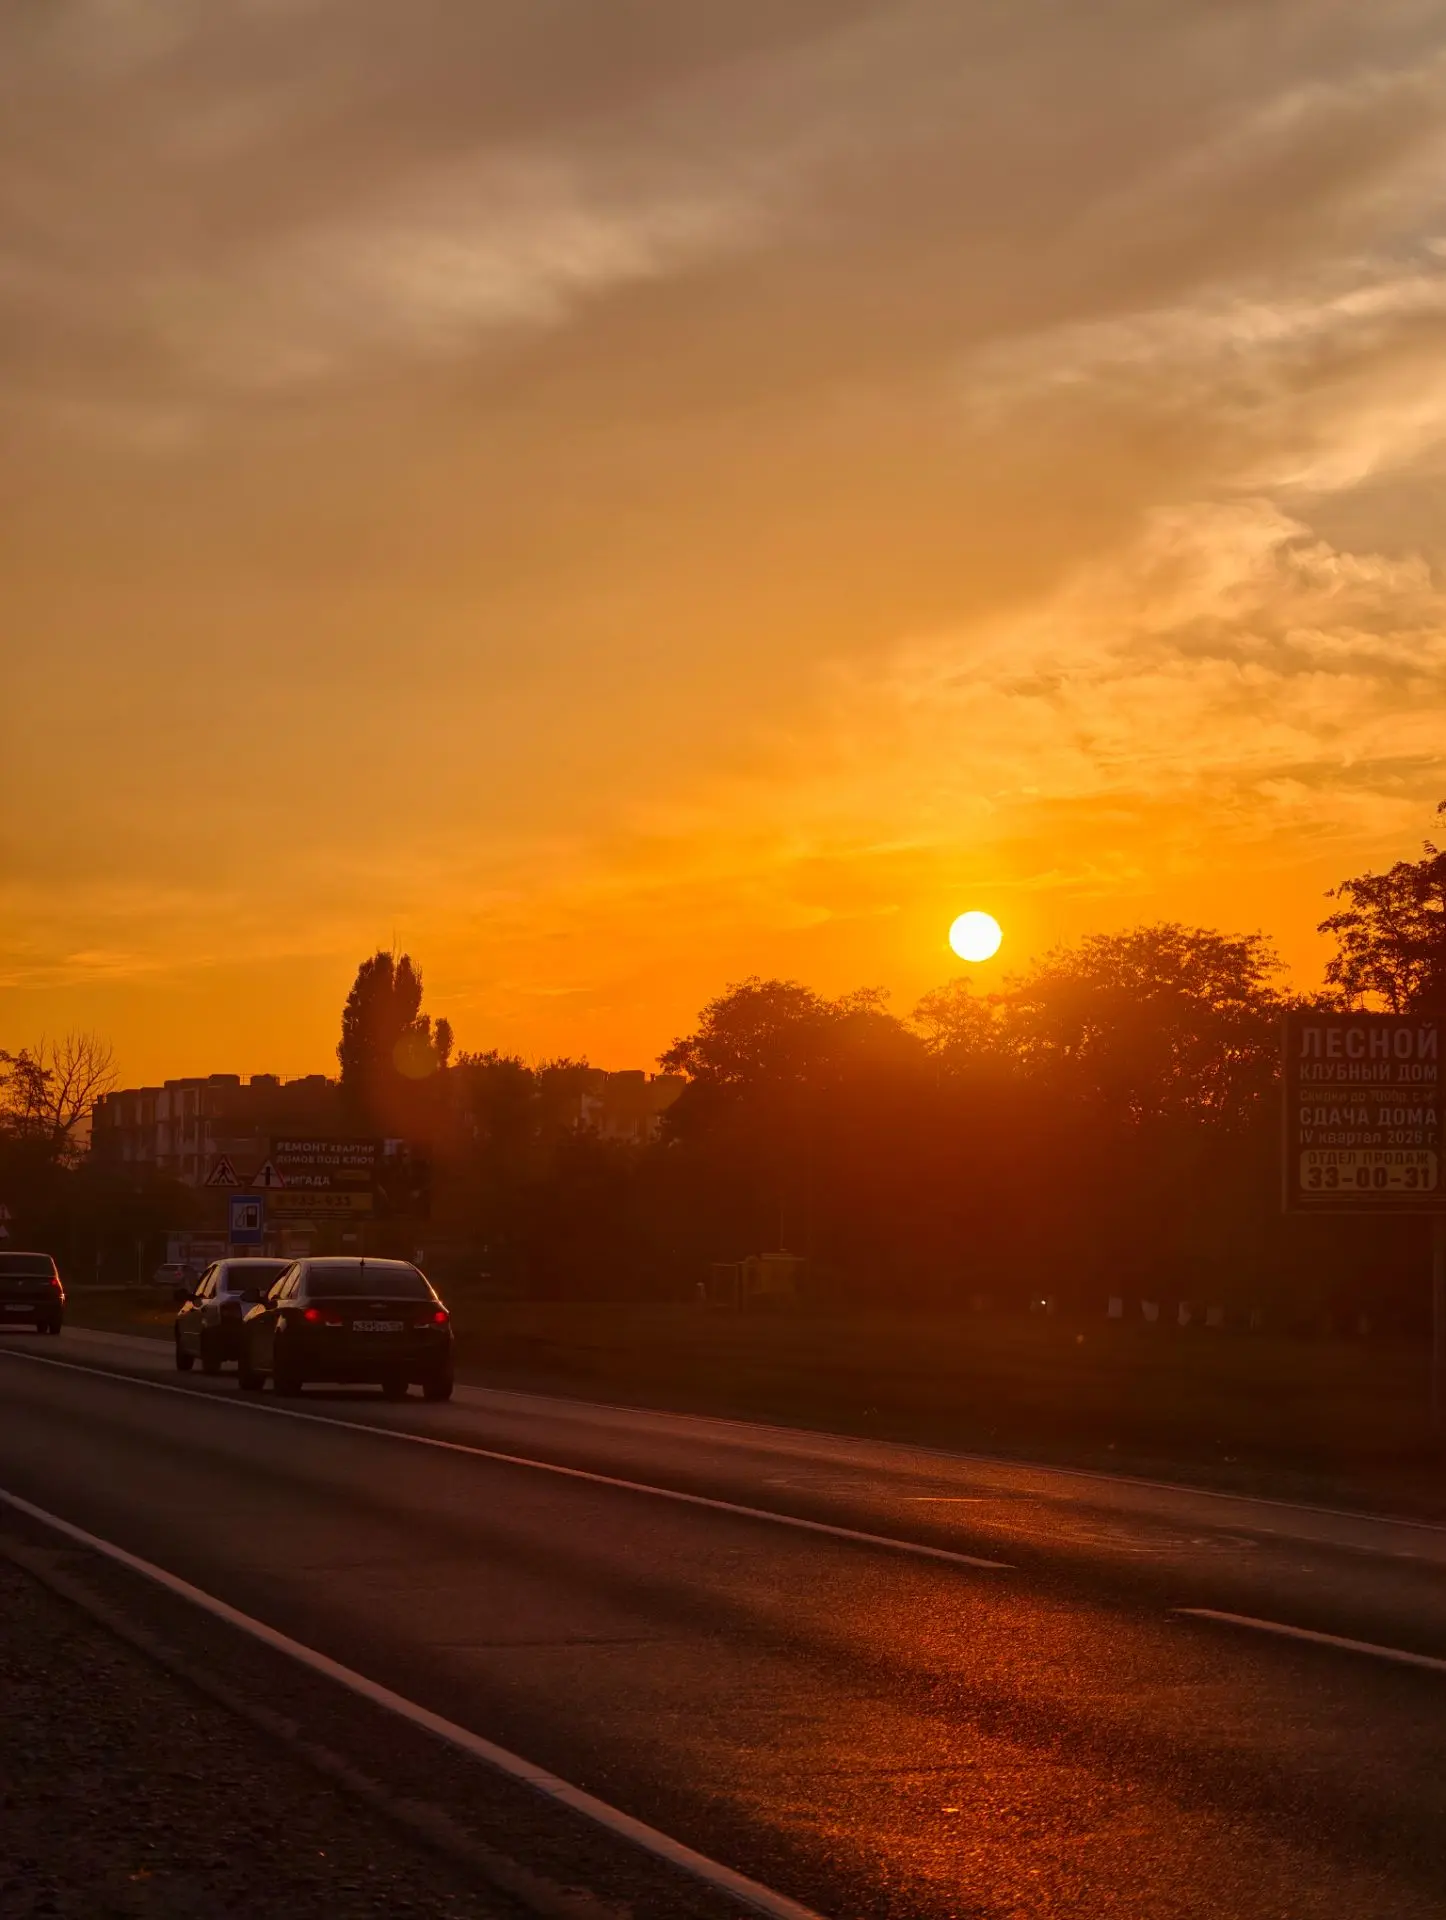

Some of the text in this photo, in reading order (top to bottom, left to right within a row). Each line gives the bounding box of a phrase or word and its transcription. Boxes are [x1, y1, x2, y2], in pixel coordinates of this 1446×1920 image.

[1300, 1022, 1438, 1059] ЛЕСНОЙ
[1300, 1062, 1438, 1082] КЛУБНЫЙ ДОМ
[1300, 1107, 1438, 1127] СДАЧА ДОМА
[276, 1141, 328, 1152] РЕМОНТ
[1300, 1130, 1314, 1144] IV
[1319, 1132, 1381, 1146] квартал
[1387, 1130, 1423, 1144] 2026
[316, 1155, 340, 1165] ПОД
[1308, 1151, 1429, 1165] ОТДЕЛ ПРОДАЖ
[1308, 1166, 1430, 1188] 33-00-31
